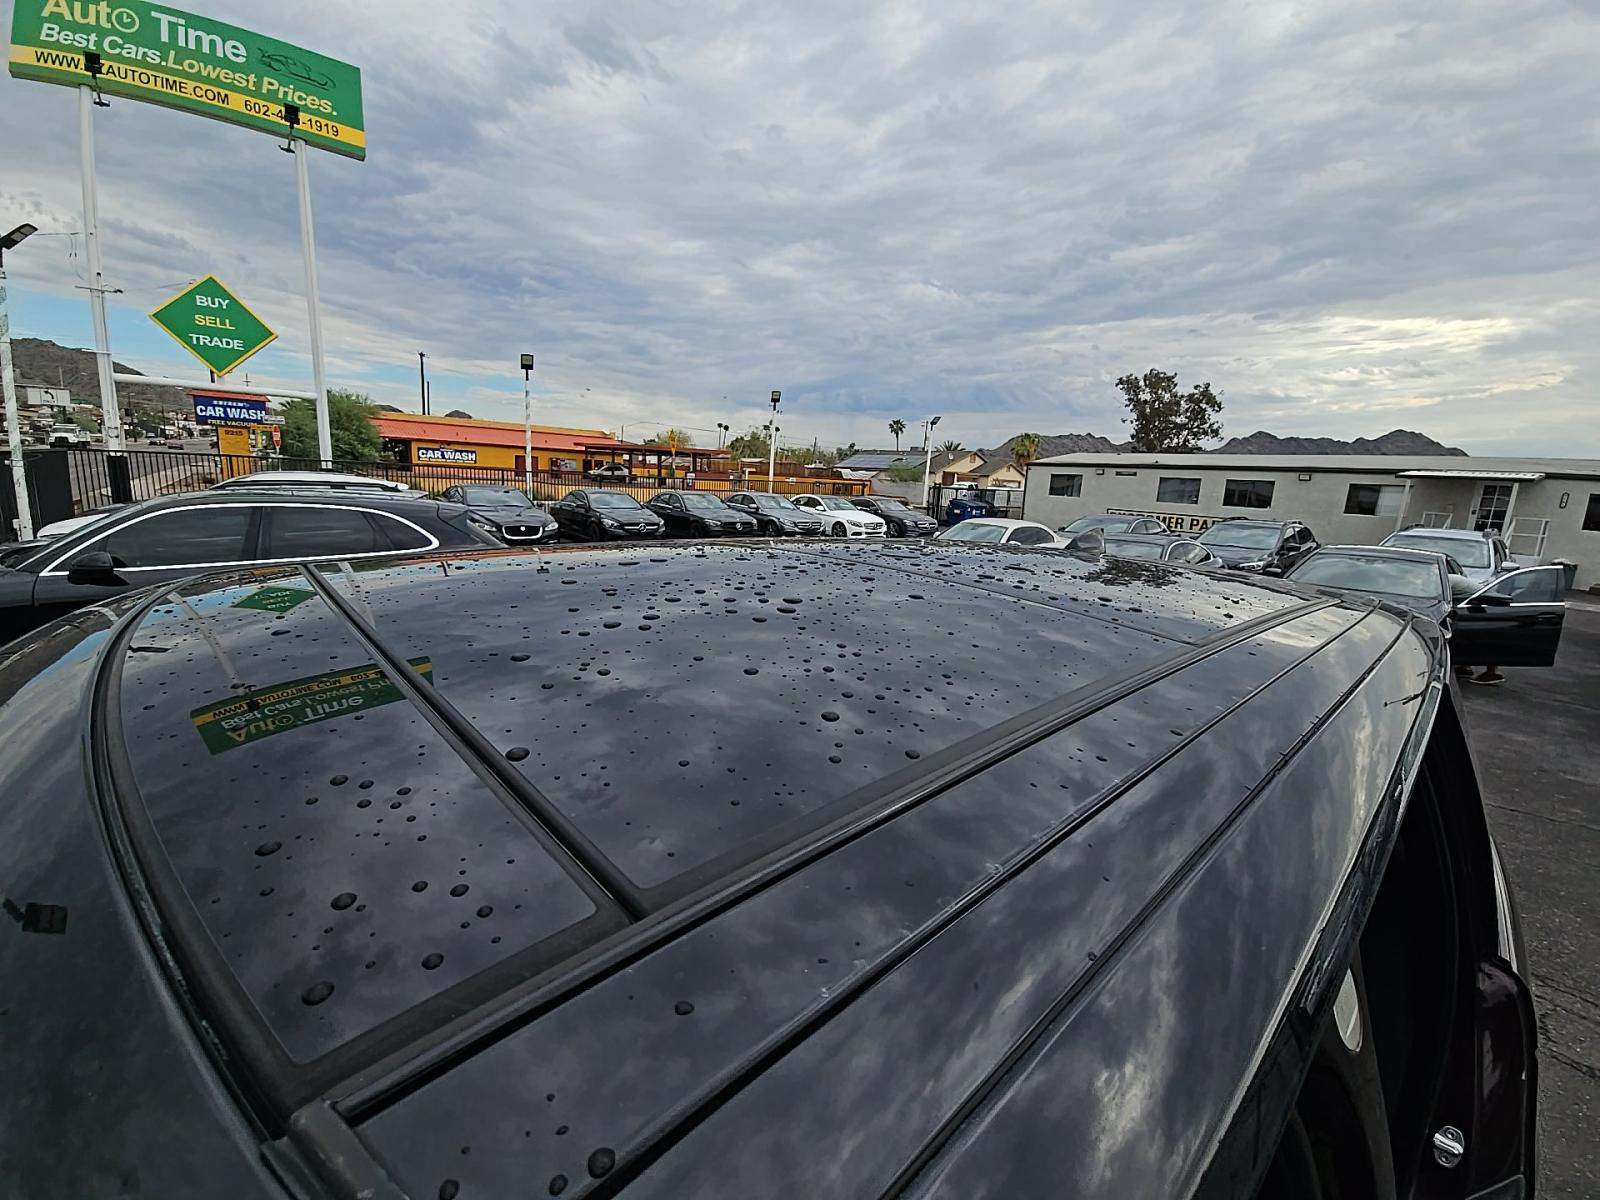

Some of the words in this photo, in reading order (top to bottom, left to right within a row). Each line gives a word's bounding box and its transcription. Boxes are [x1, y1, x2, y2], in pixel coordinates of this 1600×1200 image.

[41, 0, 139, 33] Auto
[151, 11, 247, 63] Time
[40, 23, 98, 50] Best
[262, 76, 337, 116] Prices.
[244, 99, 339, 137] 602-4-1919
[195, 295, 229, 309] BUY
[194, 314, 236, 329] SELL
[188, 333, 245, 350] TRADE
[196, 405, 225, 418] CAR
[226, 407, 266, 420] WASH
[418, 449, 442, 459] CAR
[444, 450, 476, 461] WASH
